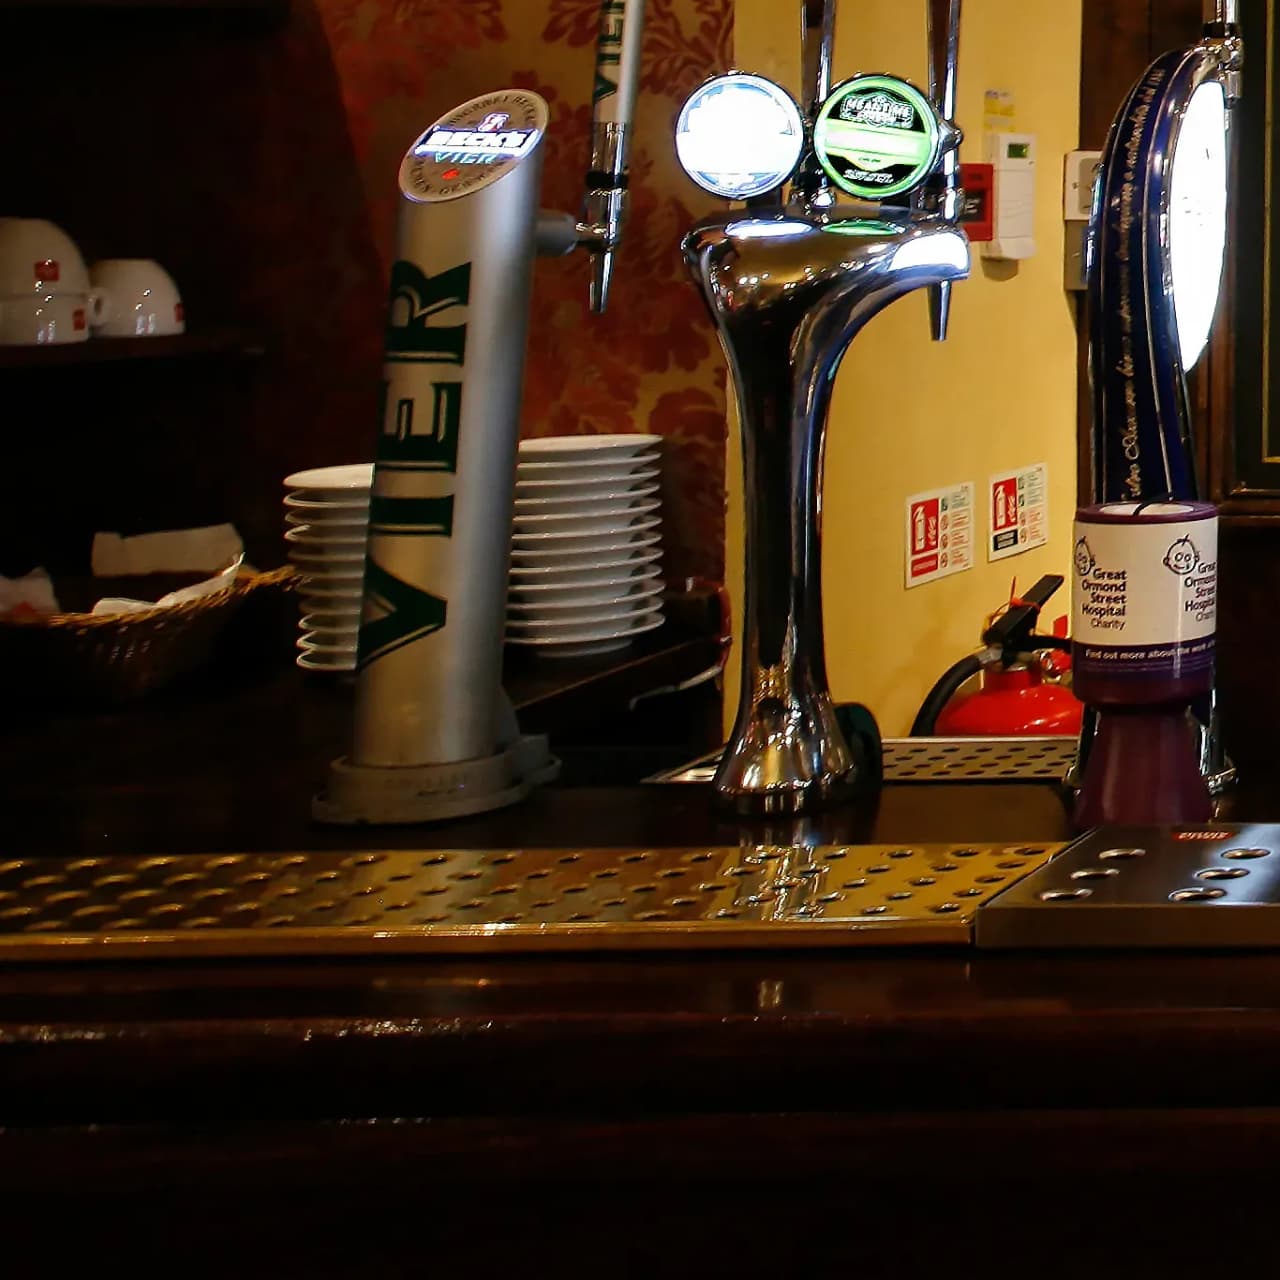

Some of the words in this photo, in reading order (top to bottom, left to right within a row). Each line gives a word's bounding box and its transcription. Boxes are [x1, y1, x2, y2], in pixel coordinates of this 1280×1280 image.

[357, 259, 472, 673] VIER
[1093, 568, 1127, 580] Great
[1082, 578, 1127, 592] Ormond
[1090, 592, 1127, 604] Street
[1082, 602, 1126, 619] Hospital
[1090, 618, 1126, 632] Charity
